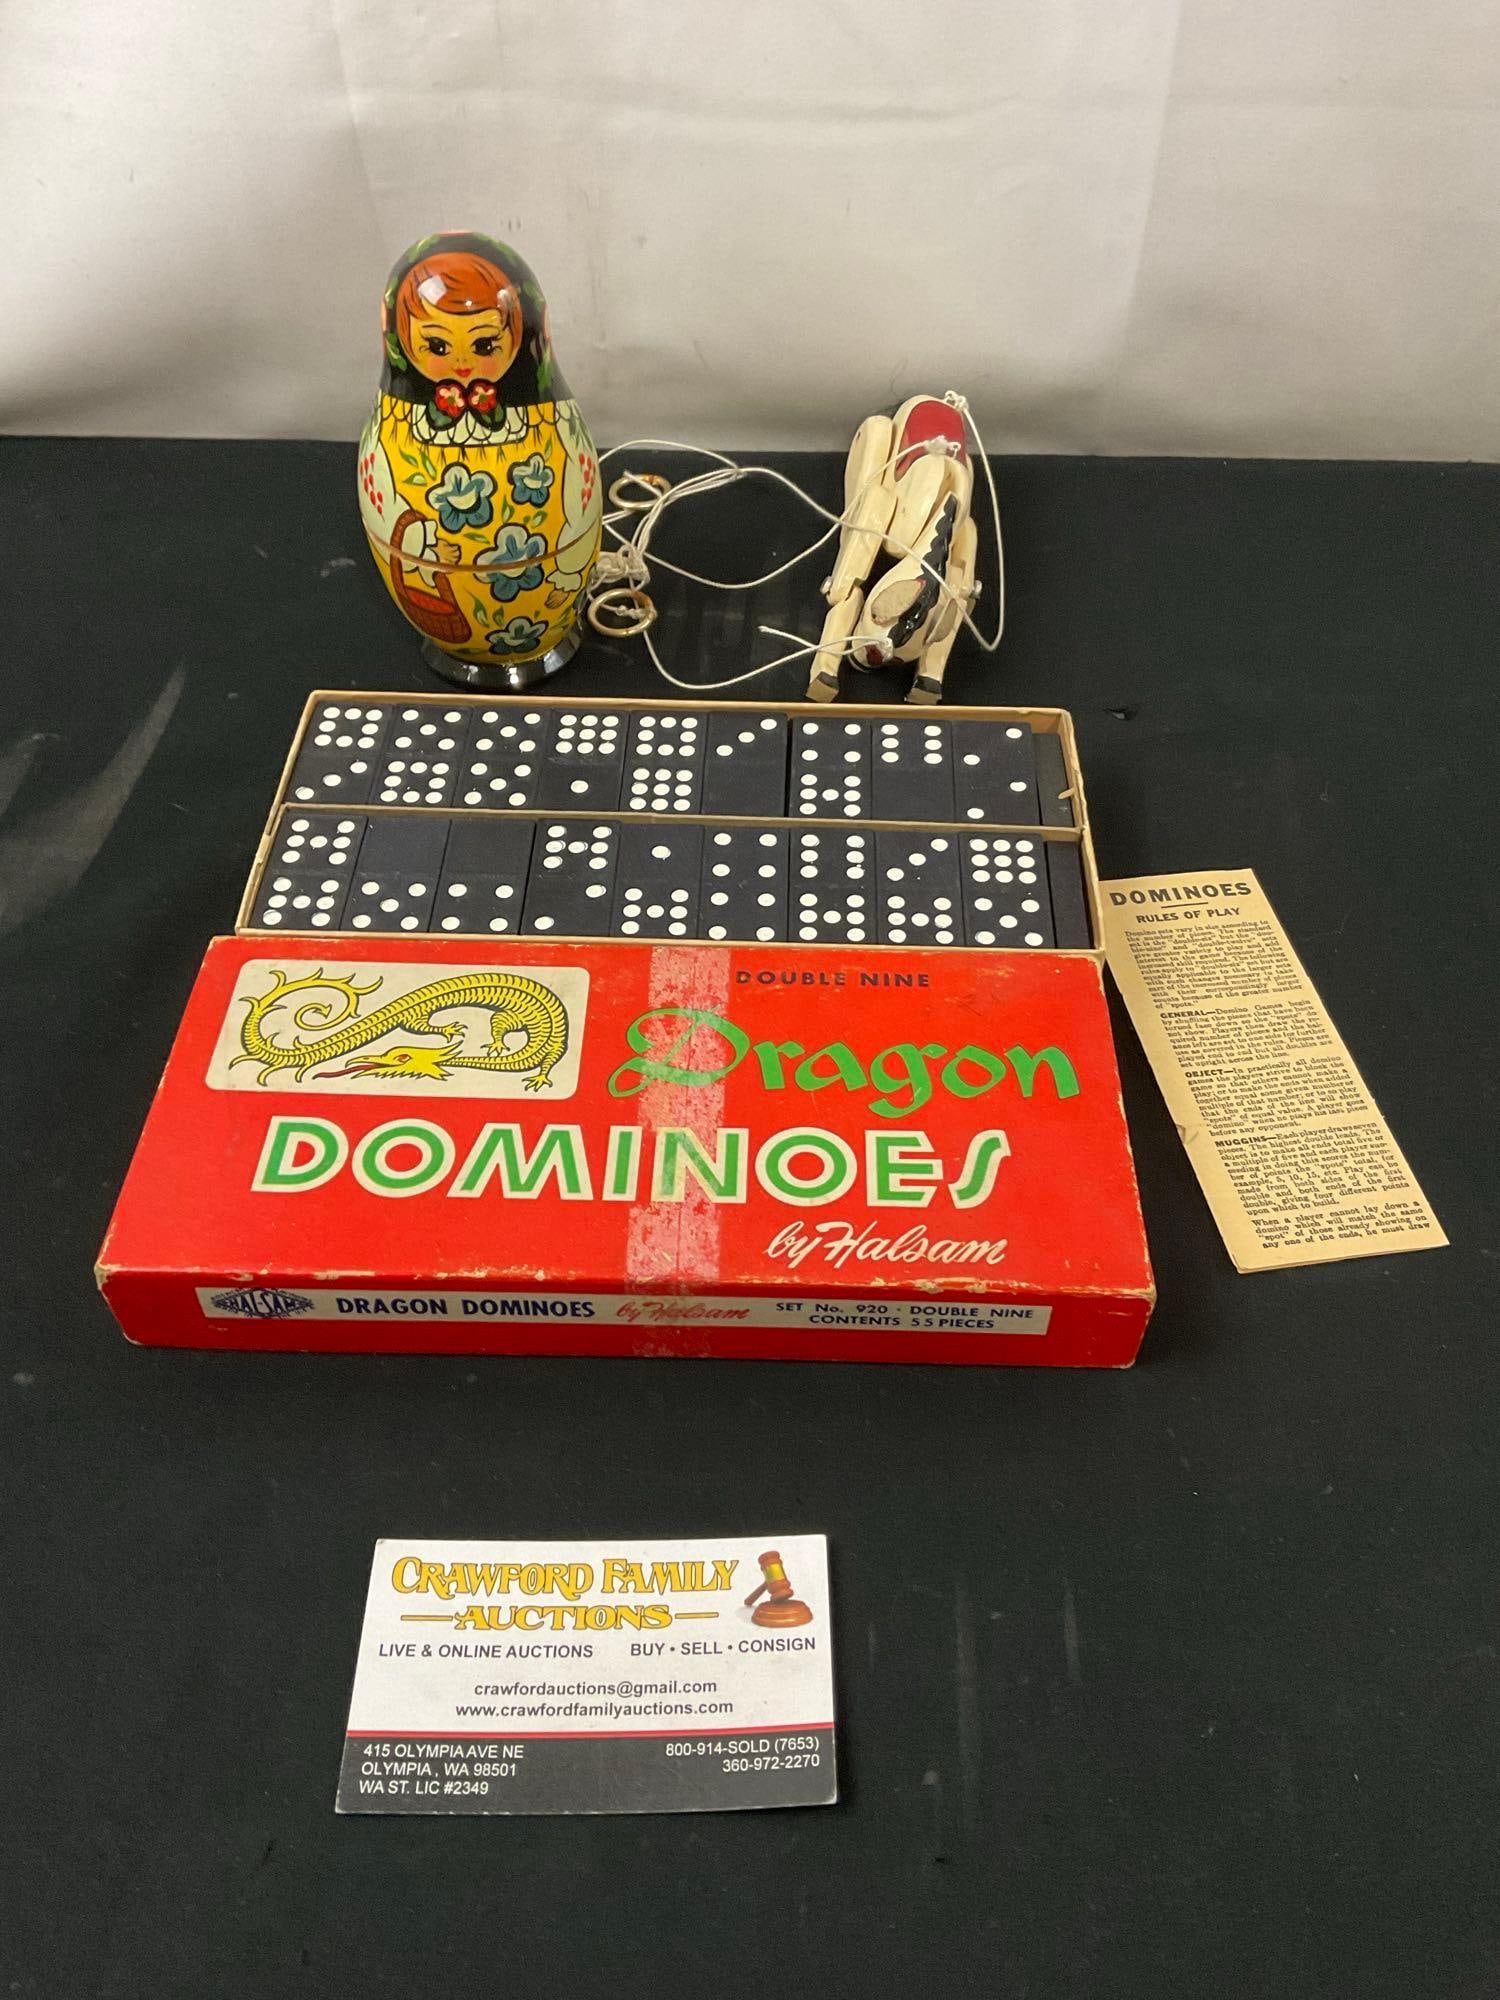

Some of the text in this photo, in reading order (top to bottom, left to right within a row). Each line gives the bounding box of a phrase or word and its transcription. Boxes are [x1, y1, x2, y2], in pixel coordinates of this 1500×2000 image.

[1109, 882, 1251, 906] DOMINOES
[1136, 907, 1241, 923] RULES OF PLAY
[735, 970, 931, 988] DOUBLE NINE
[607, 1007, 1081, 1119] Dragon
[251, 1115, 1011, 1210] DOMINOES
[763, 1221, 1008, 1269] by Halsam
[336, 1297, 596, 1317] DRAGON DOMINOES
[615, 1301, 642, 1322] by
[776, 1303, 1033, 1319] SET No. 920 DOUBLE NINE
[809, 1315, 900, 1326] CONTENTS
[939, 1318, 995, 1328] PIECES
[392, 1556, 740, 1601] CRAWFORD FAMILY
[454, 1605, 673, 1631] AUCTIONS
[379, 1643, 593, 1658] LIVE & ONLINE AUCTIONS
[630, 1637, 816, 1656] BUY SELL CONSIGN
[474, 1680, 717, 1698] crawfordauctions@gmail.com
[455, 1701, 734, 1719] www.crawfordfamilyauctions.com
[363, 1744, 524, 1758] 415 OLYMPIA AVE NE
[665, 1736, 819, 1757] 800-914-SOLD (7653)
[444, 1763, 470, 1776] WA
[473, 1763, 516, 1777] 98501
[722, 1754, 820, 1772] 360-972-2270
[359, 1780, 489, 1795] WA ST. LIC #2349
